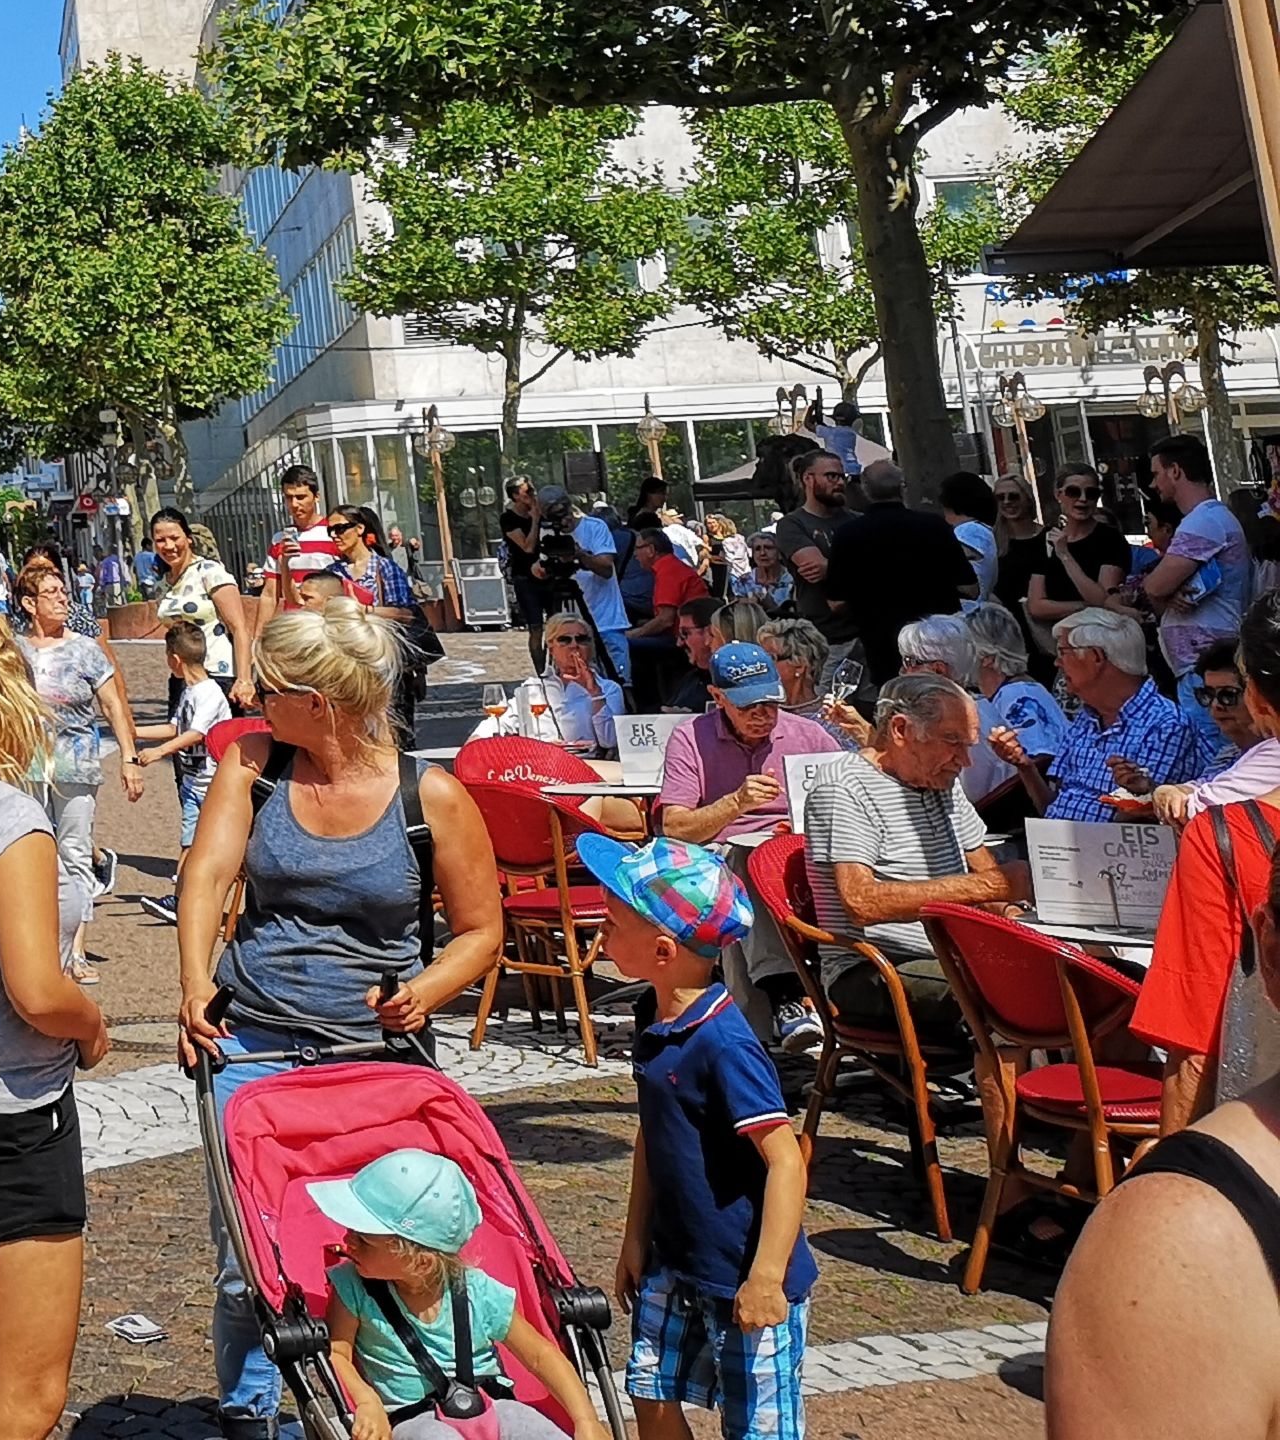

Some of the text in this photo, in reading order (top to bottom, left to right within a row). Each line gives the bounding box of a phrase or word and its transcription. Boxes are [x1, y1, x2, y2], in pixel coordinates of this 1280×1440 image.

[631, 723, 656, 738] EIS
[629, 736, 659, 747] CAFE
[1120, 825, 1160, 846] EIS
[1103, 841, 1151, 859] CAFE
